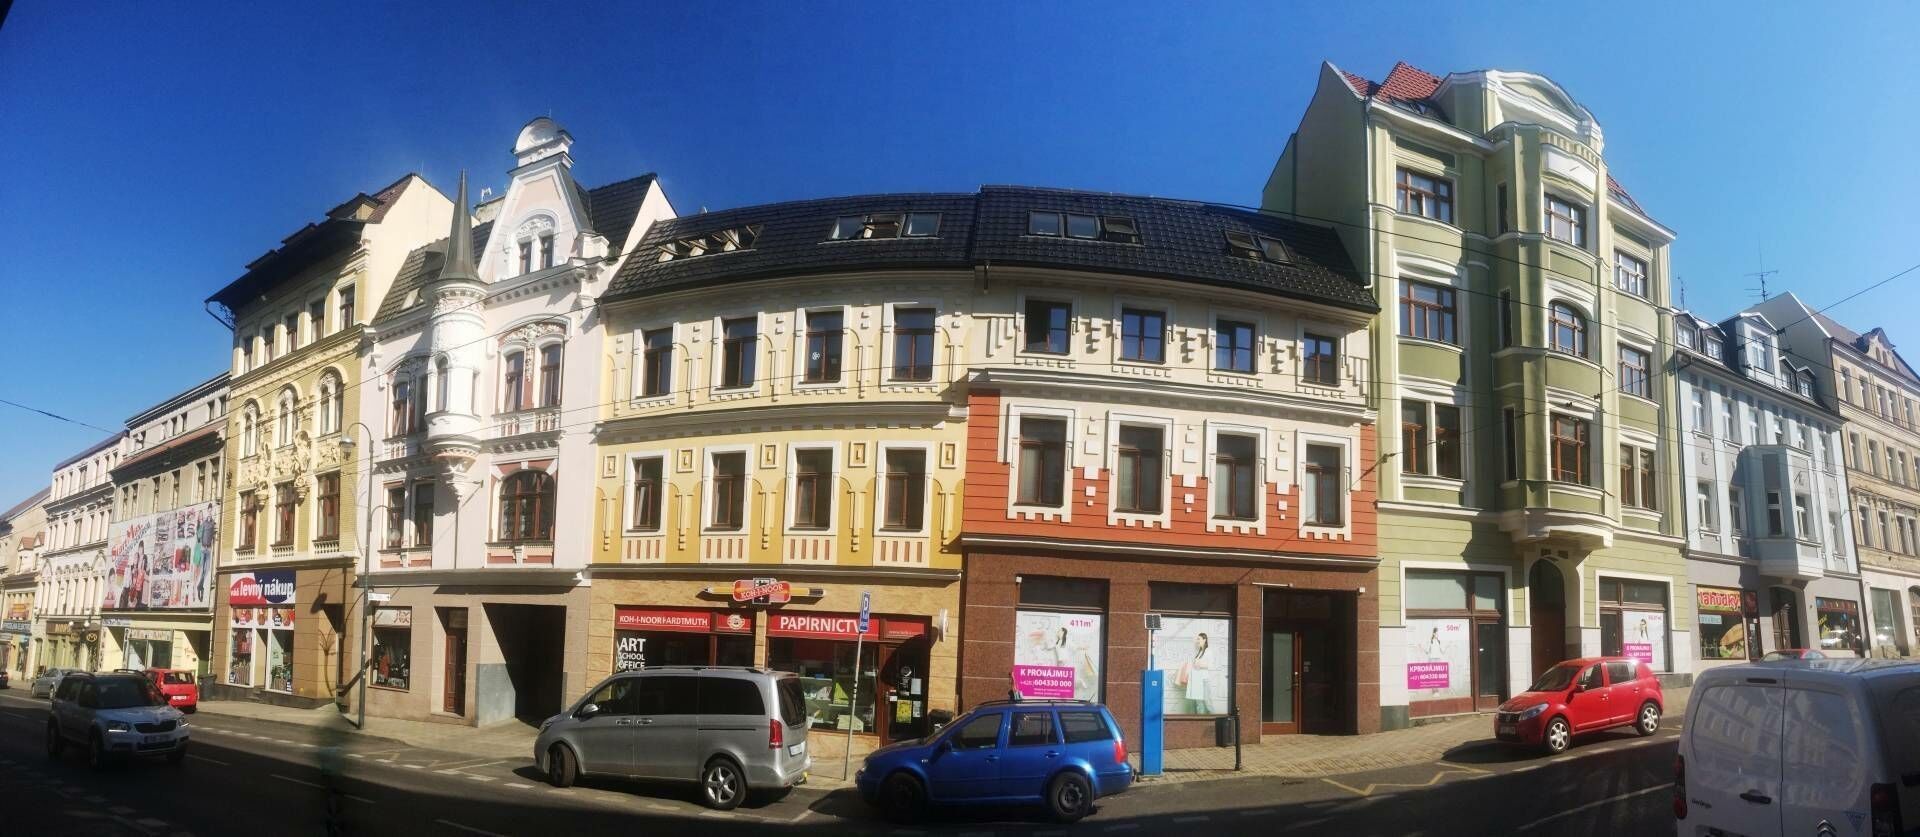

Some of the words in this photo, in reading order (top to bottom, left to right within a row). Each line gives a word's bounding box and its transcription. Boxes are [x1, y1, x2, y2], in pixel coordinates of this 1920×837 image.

[240, 579, 263, 600] levný
[264, 578, 294, 598] nákup
[740, 583, 784, 599] KOH-I-NOOR
[780, 616, 861, 634] PAPÍRNICTV
[619, 637, 646, 652] ART
[618, 660, 645, 669] OFFICE
